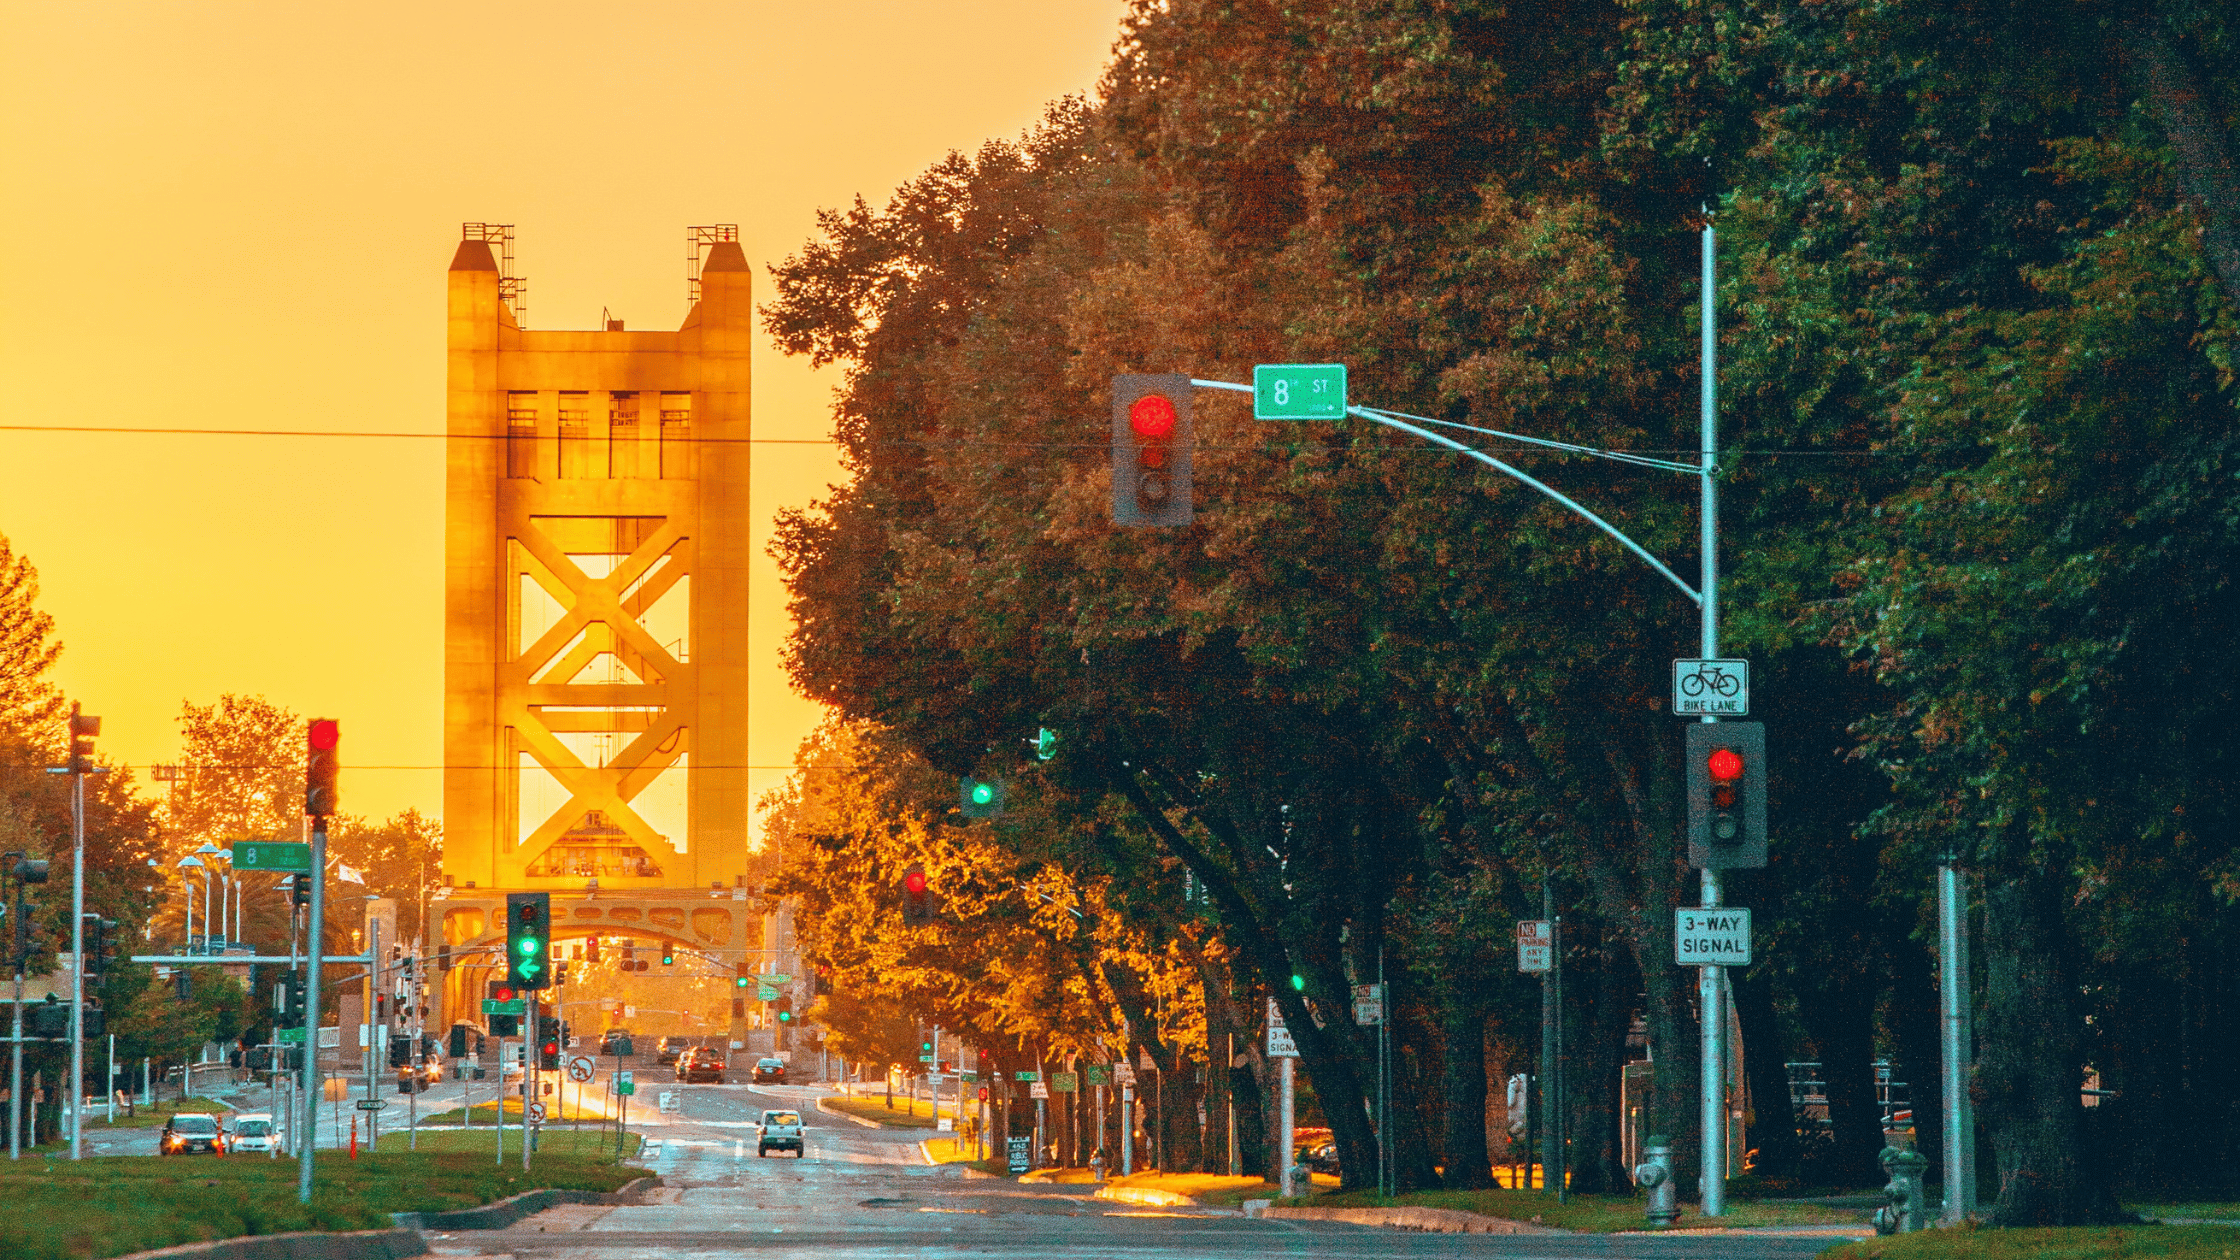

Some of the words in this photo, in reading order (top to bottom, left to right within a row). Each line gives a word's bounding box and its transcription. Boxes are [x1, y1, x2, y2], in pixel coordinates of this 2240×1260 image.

[1274, 379, 1289, 405] 8
[1312, 379, 1328, 393] ST
[1683, 700, 1706, 711] BIKE
[1711, 700, 1737, 711] LANE
[247, 848, 256, 864] 8
[1521, 923, 1535, 937] NO
[1685, 916, 1740, 931] 3-WAY
[1683, 938, 1745, 954] SIGNAL
